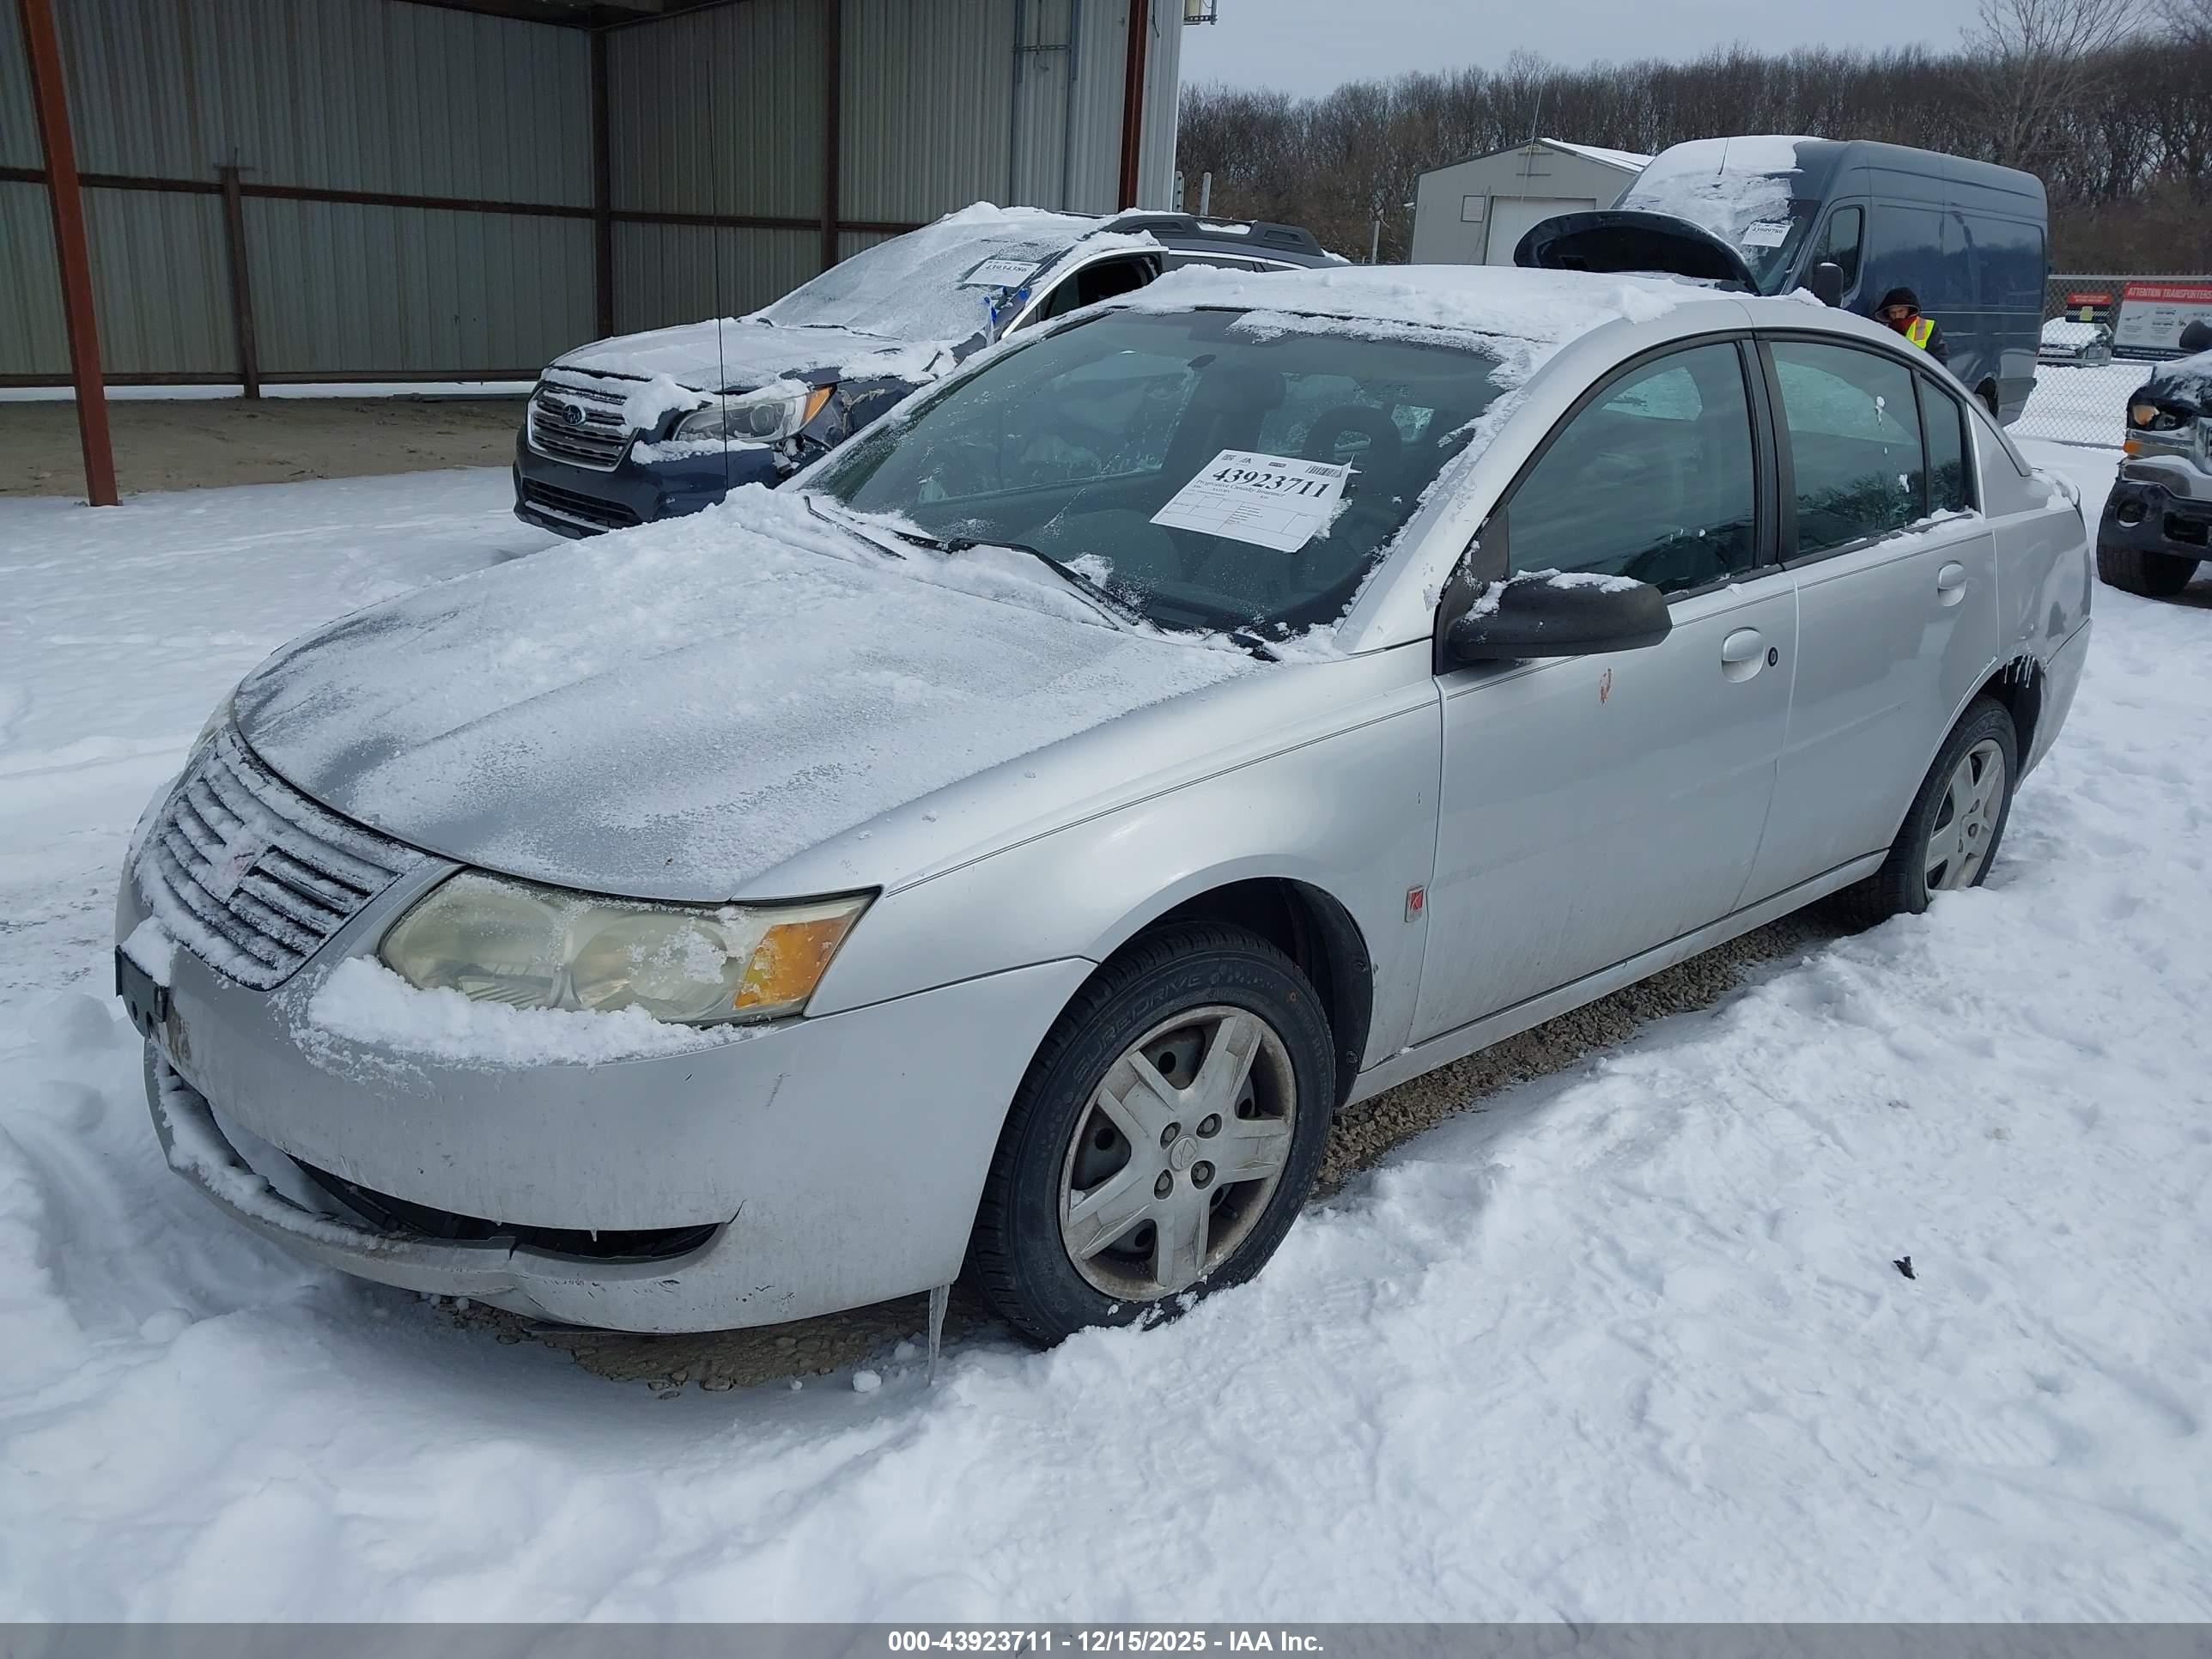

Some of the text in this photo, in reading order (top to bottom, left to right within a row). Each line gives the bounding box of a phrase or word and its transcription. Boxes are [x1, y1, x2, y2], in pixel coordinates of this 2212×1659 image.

[2128, 287, 2162, 298] ATTENTION
[1212, 467, 1330, 498] 43923711
[1255, 488, 1285, 497] Insurance
